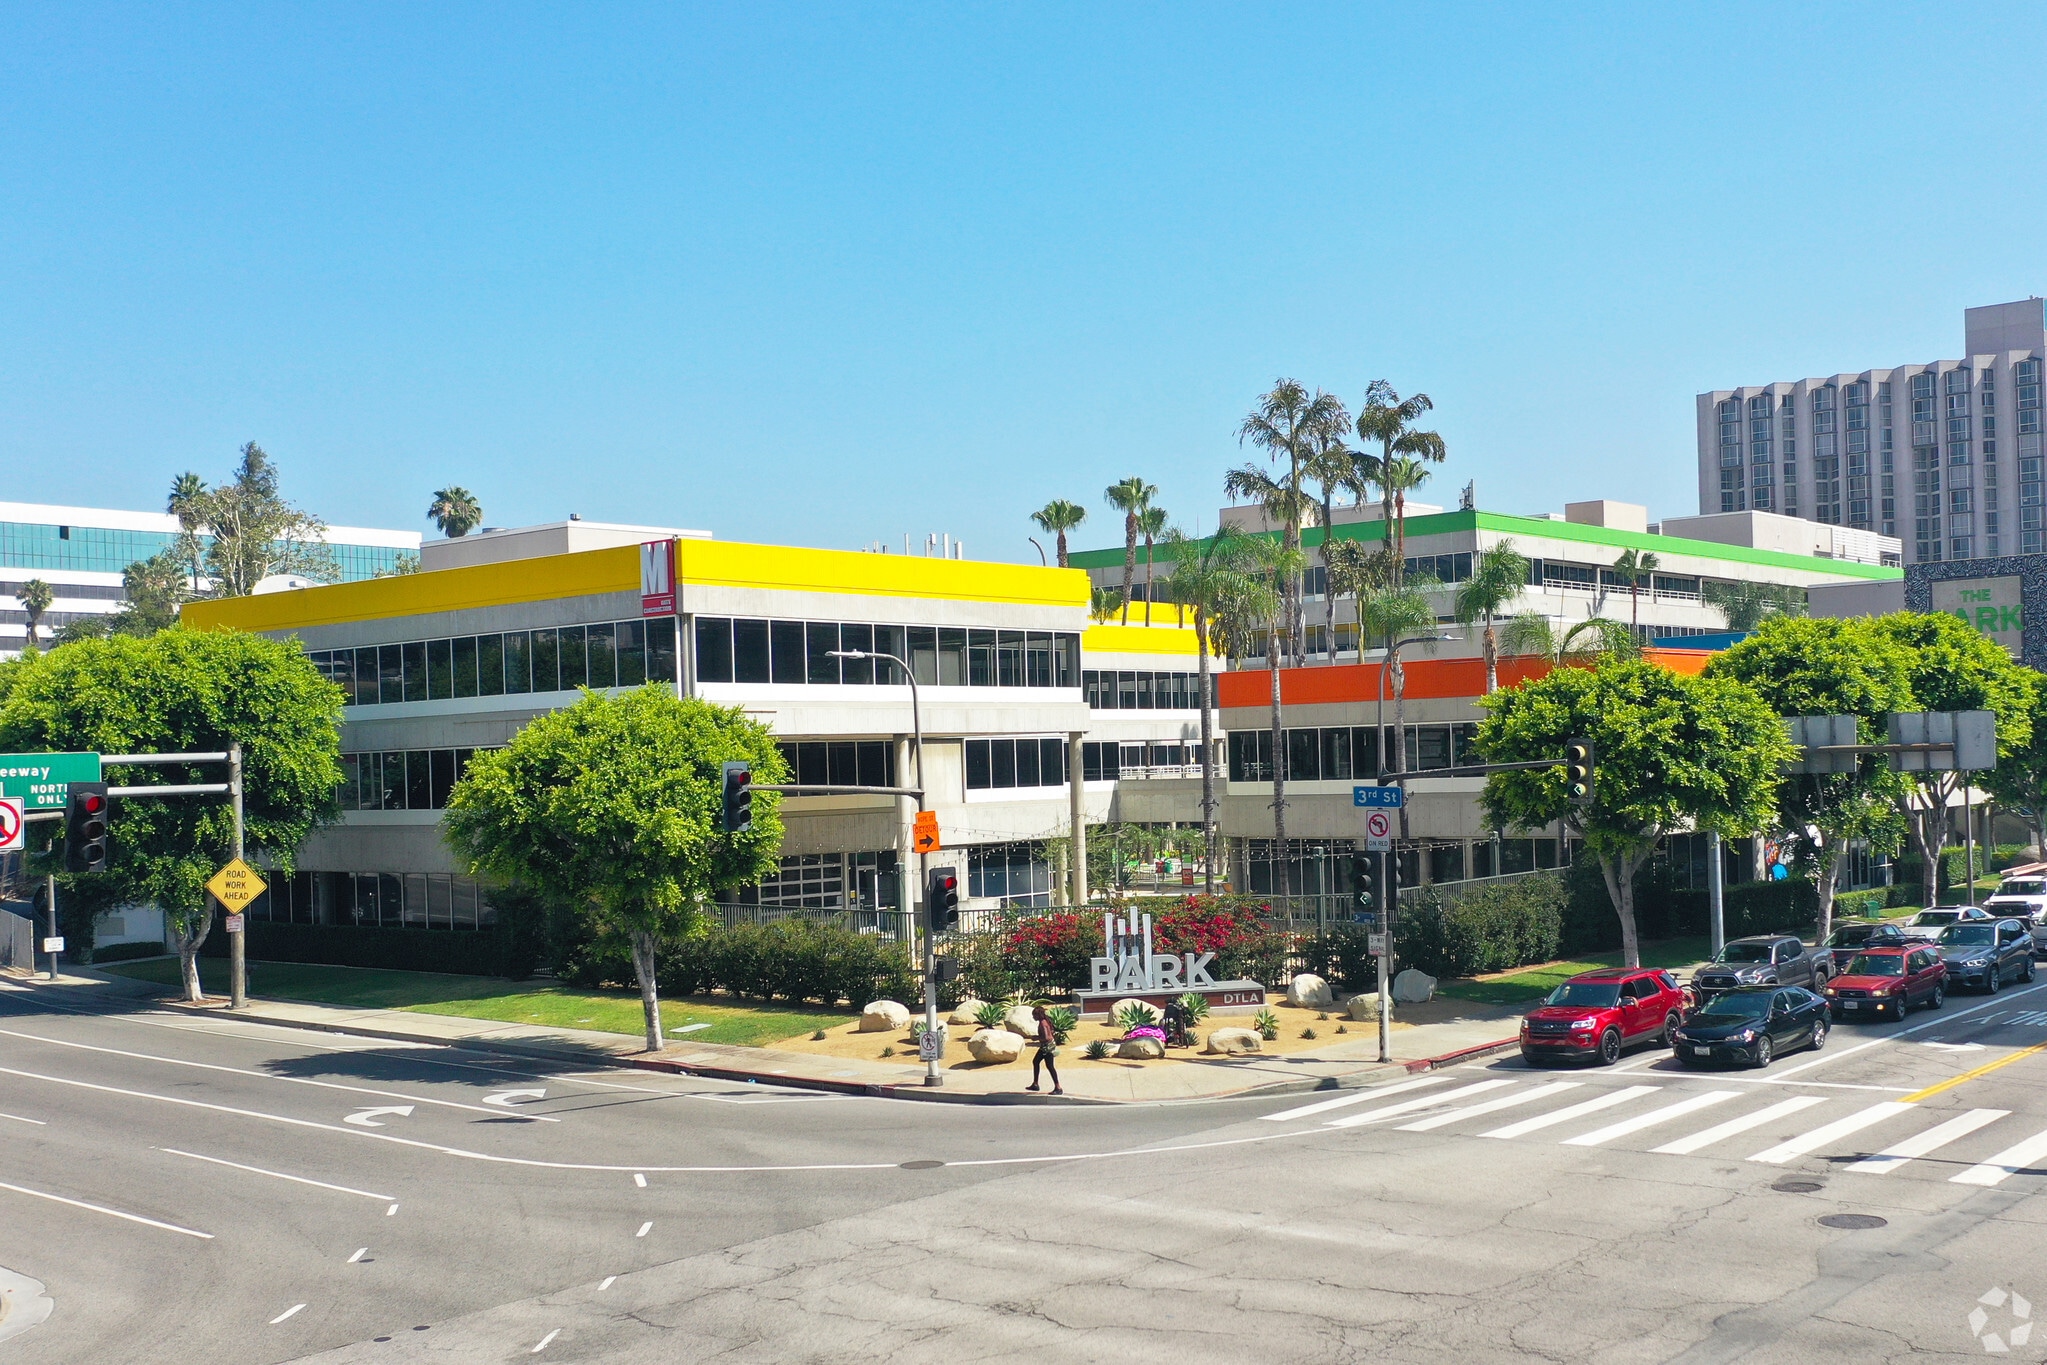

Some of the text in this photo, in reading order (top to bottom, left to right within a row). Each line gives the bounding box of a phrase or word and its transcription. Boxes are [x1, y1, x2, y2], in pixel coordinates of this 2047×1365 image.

[1959, 589, 1991, 603] THE
[1931, 604, 2025, 632] ARK
[30, 783, 68, 794] NORT
[37, 795, 68, 805] ONL
[1358, 790, 1397, 804] 3rd St
[915, 825, 936, 834] DETOUR
[226, 870, 247, 878] ROAD
[225, 881, 247, 889] WORK
[223, 891, 249, 900] AHEAD
[1091, 951, 1217, 993] PARK
[1223, 992, 1260, 1004] DTLA
